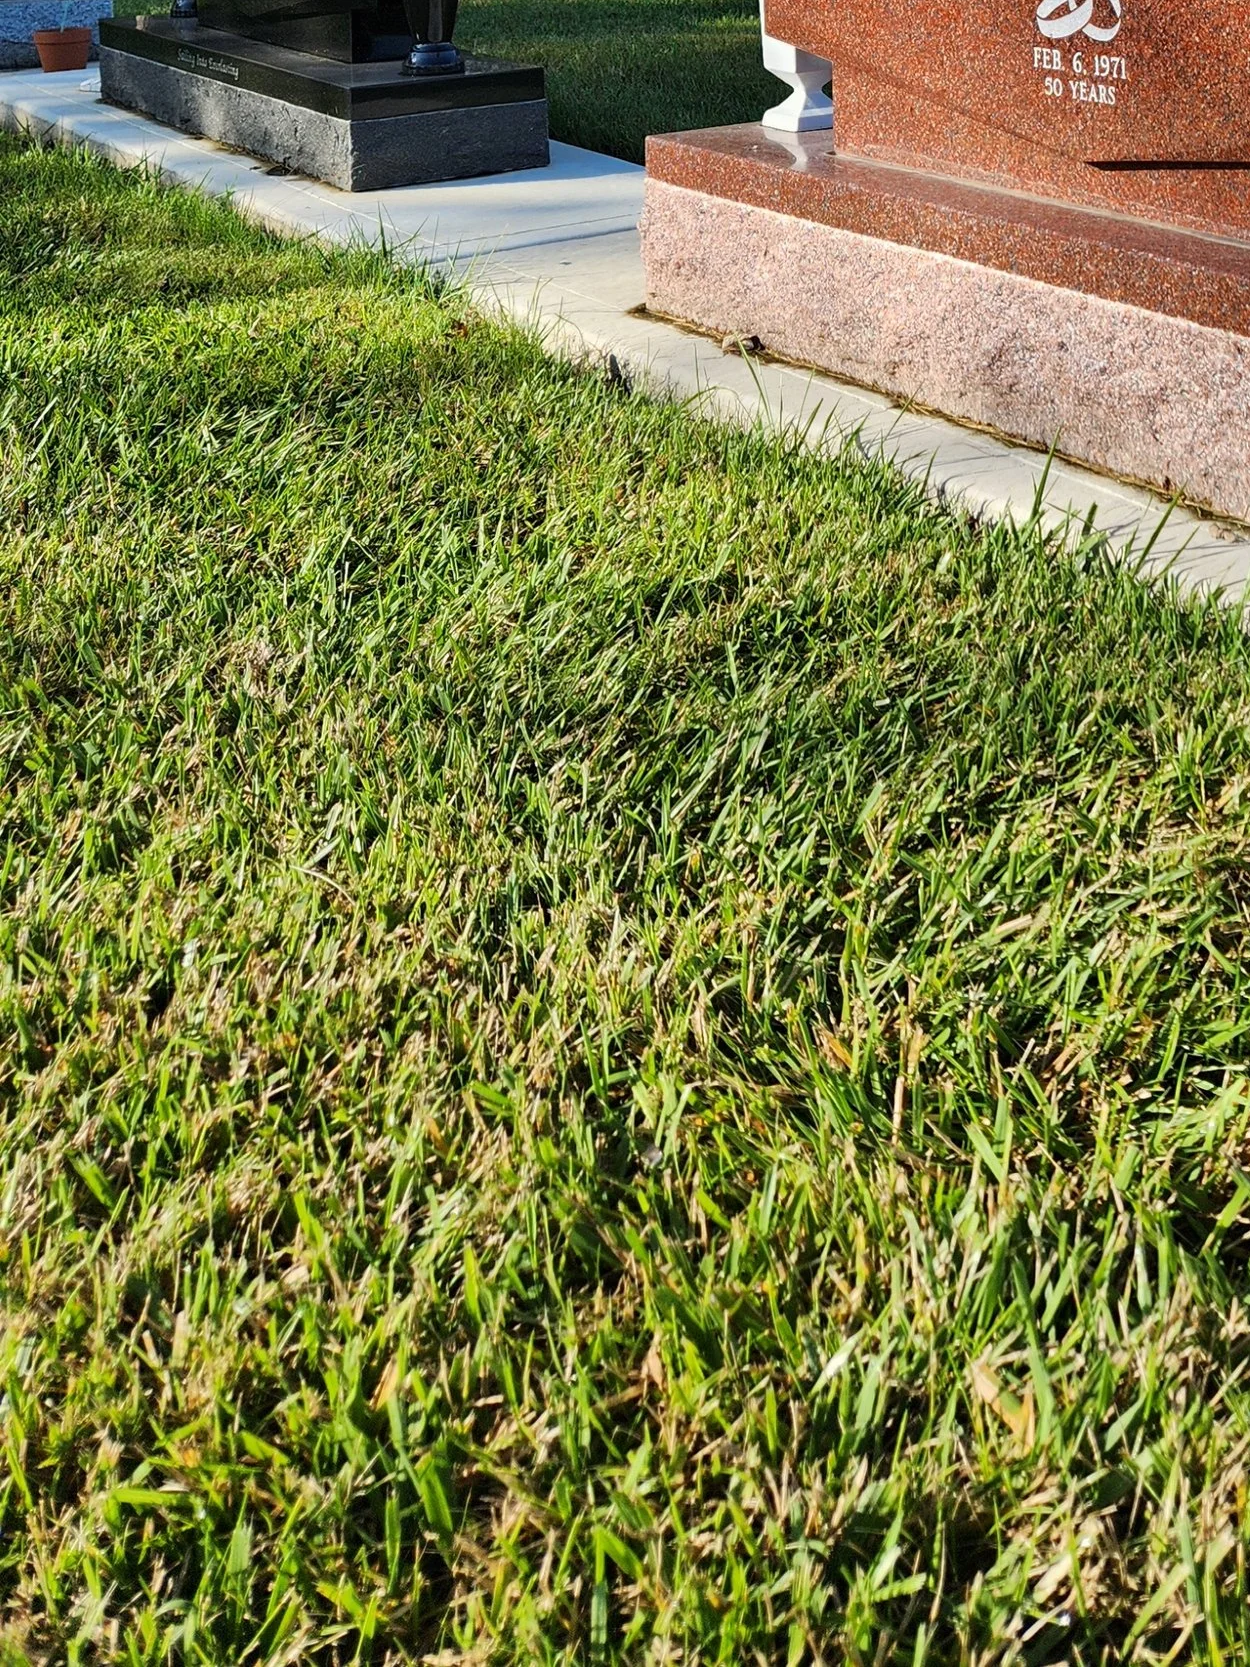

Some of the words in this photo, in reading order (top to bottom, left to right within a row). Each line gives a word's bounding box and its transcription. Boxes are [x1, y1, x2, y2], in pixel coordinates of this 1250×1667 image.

[1033, 46, 1065, 71] FEB.
[1094, 54, 1127, 79] 1971
[1044, 77, 1063, 96] 50
[1069, 80, 1116, 105] YEARS
